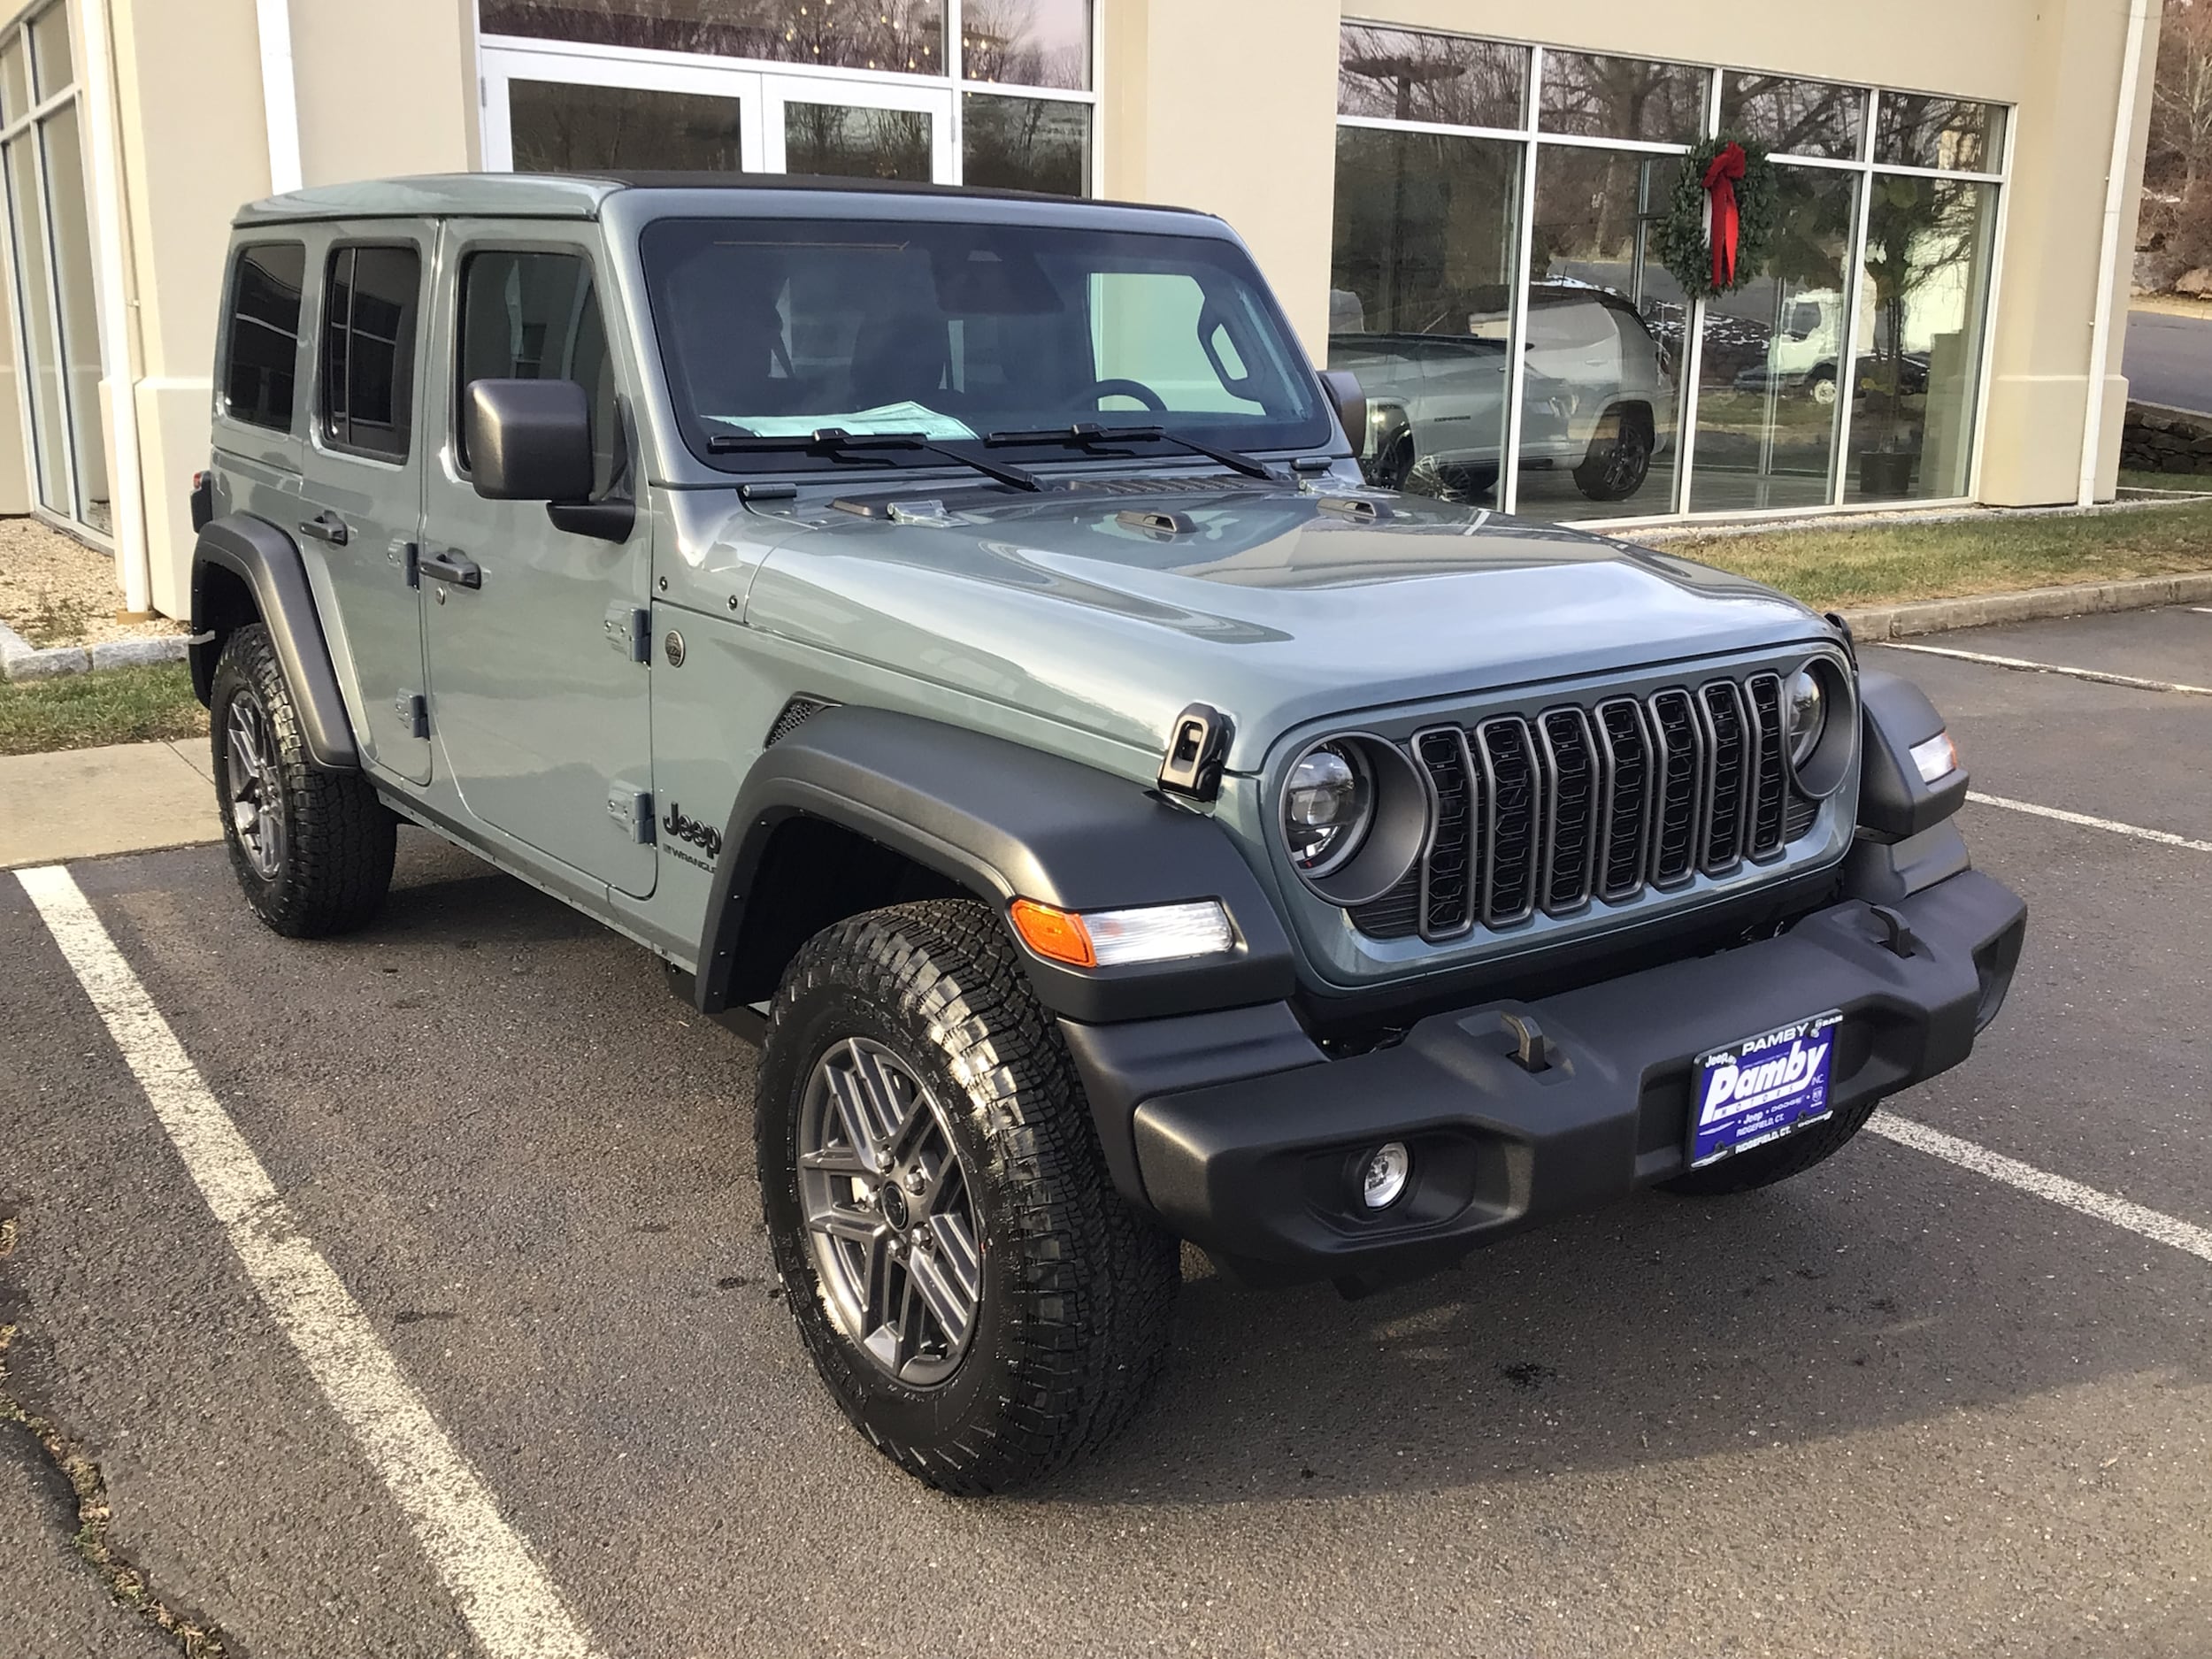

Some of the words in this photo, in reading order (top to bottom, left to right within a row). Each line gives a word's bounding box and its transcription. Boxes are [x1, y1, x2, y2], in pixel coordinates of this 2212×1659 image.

[663, 802, 721, 859] Jeep
[1741, 1022, 1809, 1056] PAMBY
[1705, 1052, 1728, 1068] Jeep
[1699, 1040, 1829, 1126] Pamby
[1743, 1111, 1763, 1125] Jeep
